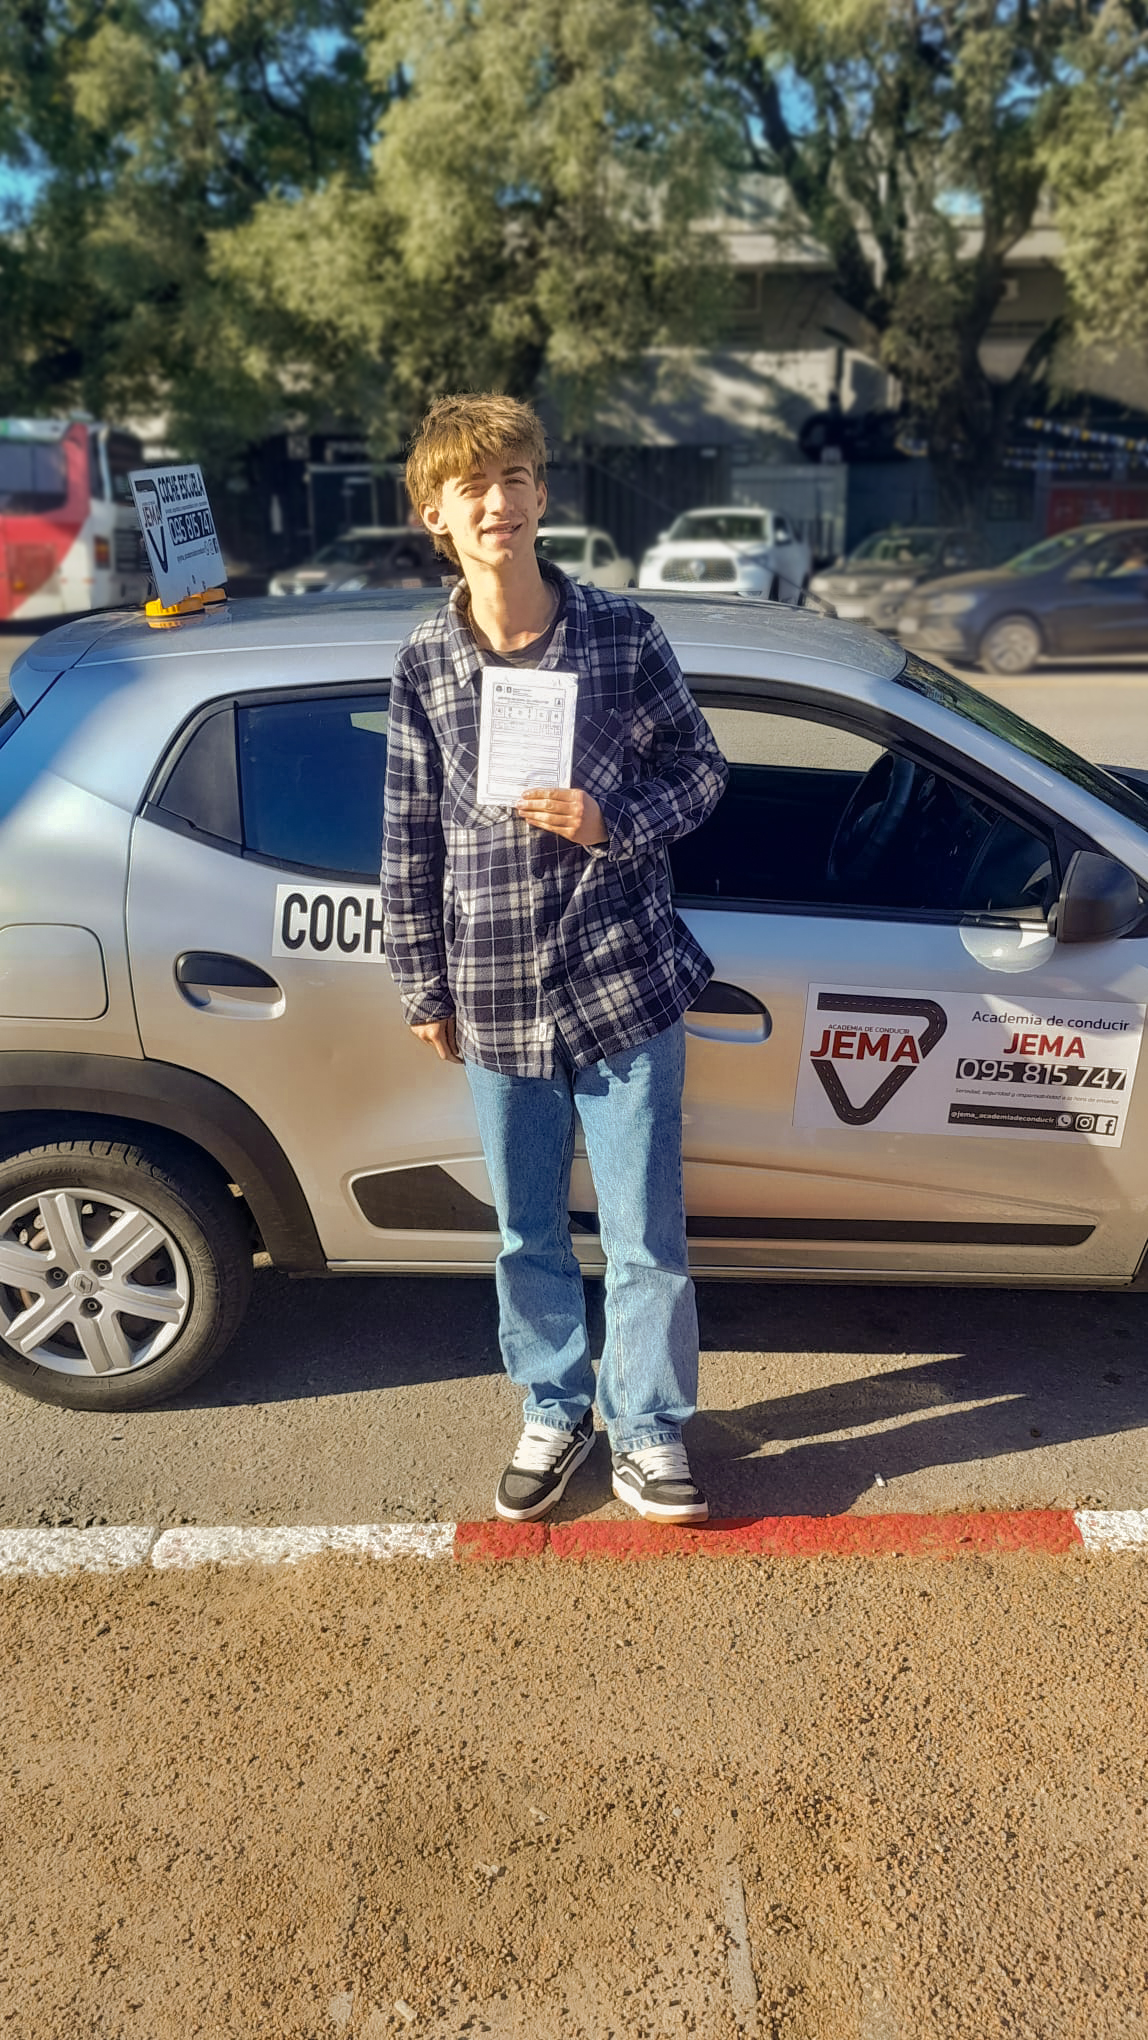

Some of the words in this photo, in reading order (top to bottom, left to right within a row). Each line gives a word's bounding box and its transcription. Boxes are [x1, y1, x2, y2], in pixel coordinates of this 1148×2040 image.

[828, 1023, 863, 1032] ACADEMIA
[875, 1026, 910, 1035] CONDUCIR
[971, 1010, 1042, 1026] Academia
[1046, 1015, 1064, 1027] de
[1067, 1018, 1131, 1031] conducir
[809, 1029, 920, 1064] JEMA
[1003, 1033, 1086, 1059] JEMA
[959, 1058, 1015, 1082] 095
[1022, 1062, 1068, 1086] 815
[1076, 1066, 1128, 1090] 747
